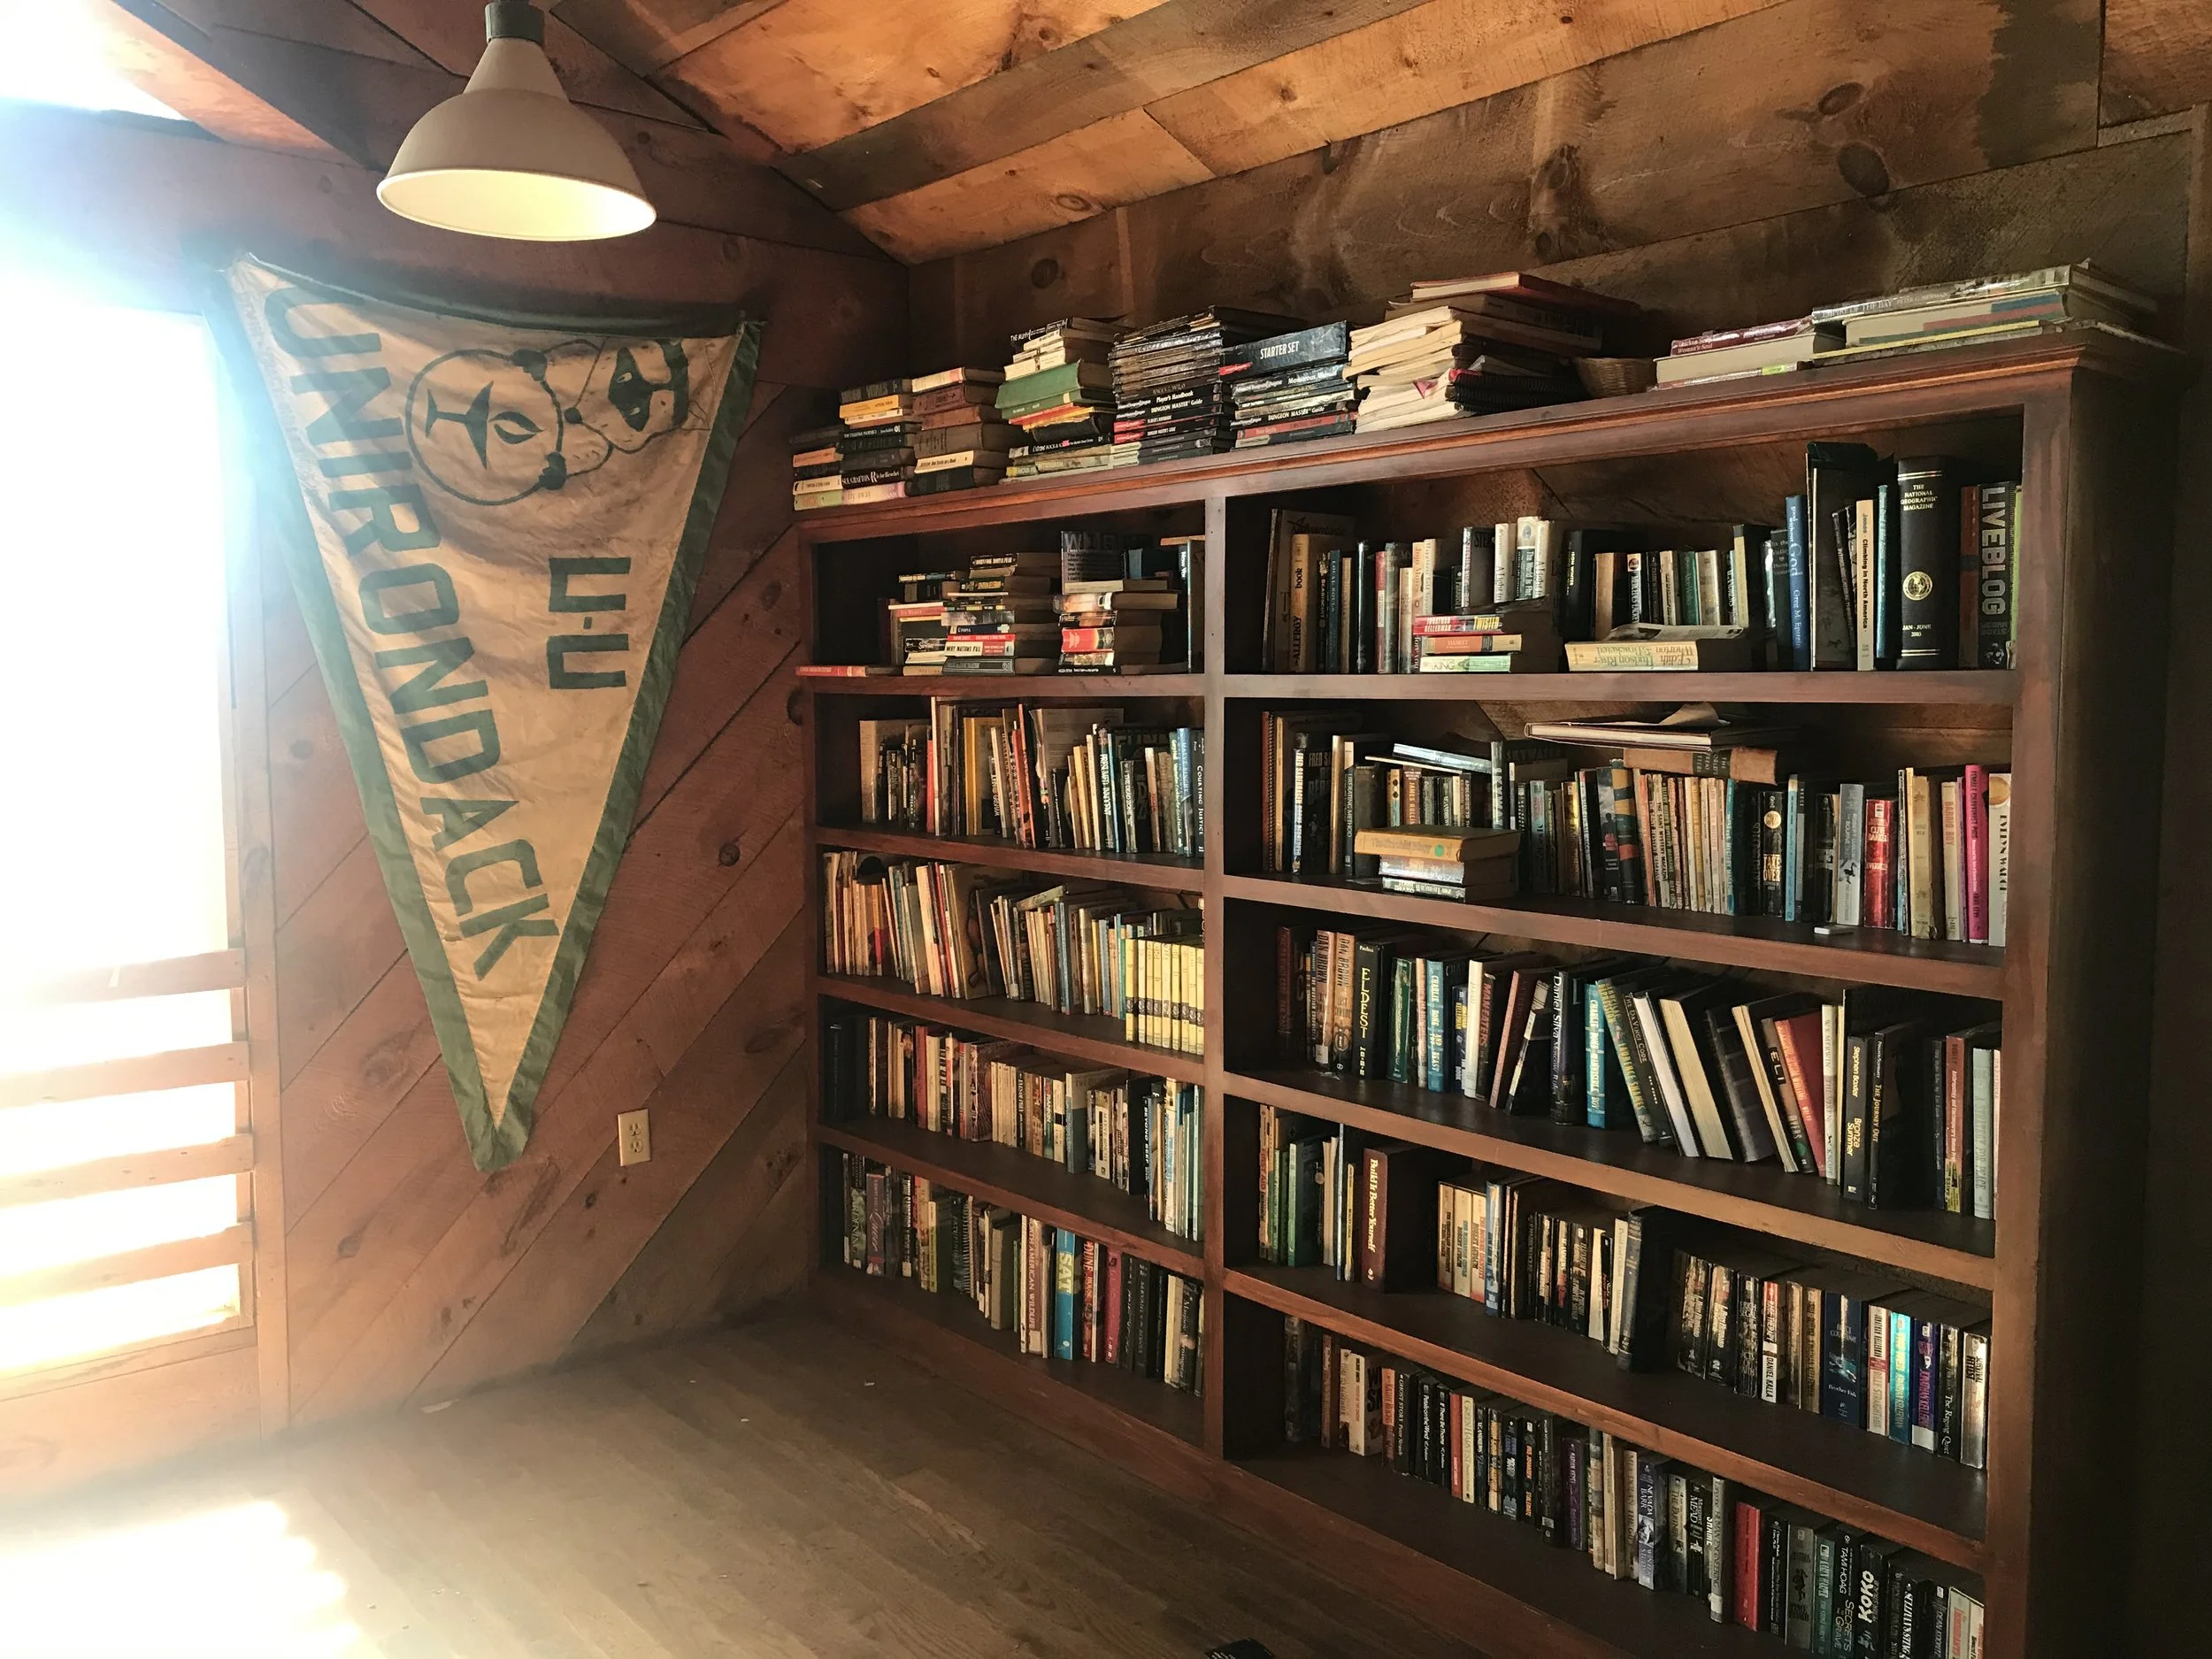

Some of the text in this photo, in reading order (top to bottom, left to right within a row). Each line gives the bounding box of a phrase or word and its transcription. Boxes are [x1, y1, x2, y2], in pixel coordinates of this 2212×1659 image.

[1260, 341, 1300, 359] STARTER SET
[1151, 403, 1171, 414] DUNGEON
[1172, 389, 1194, 401] Handbook
[1268, 410, 1290, 422] DUNGEON
[1789, 542, 1802, 577] God
[1981, 487, 2006, 616] LIVEBLOG
[1494, 572, 1504, 590] Light
[265, 285, 559, 980] UNIRONDACK
[548, 557, 632, 689] U-U
[1793, 622, 1802, 648] Epstein
[1944, 801, 1955, 846] BARRIO BOY
[1763, 869, 1780, 881] OVER
[1317, 934, 1329, 983] DAN BROWN
[1337, 938, 1349, 987] DAN BROWN
[1359, 967, 1371, 1039] ELDEST
[1553, 975, 1562, 1039] Daniel Silva
[1624, 994, 1646, 1064] THE CODE
[1617, 1043, 1644, 1110] LAURENCE SHAMES
[1770, 1050, 1786, 1081] ELI
[1852, 1046, 1861, 1074] Stephen
[1872, 1098, 1882, 1126] JOURNEY
[1370, 1159, 1379, 1183] Build
[1367, 1217, 1376, 1253] Yourself
[1057, 1252, 1072, 1294] SAT
[1083, 1242, 1094, 1271] DUNE
[1874, 1315, 1883, 1357] JONATHAN KELLERMAN
[1765, 1379, 1774, 1398] KALLA
[1873, 1371, 1882, 1387] BILLY
[1464, 1400, 1473, 1426] GREEN
[1942, 1409, 1953, 1434] Raging
[1941, 1435, 1952, 1455] Quiet
[1839, 1547, 1848, 1594] TAMI HOAG
[1857, 1570, 1875, 1624] KOKO
[1834, 1616, 1844, 1649] GRAVE
[1843, 1600, 1855, 1652] SECRETS
